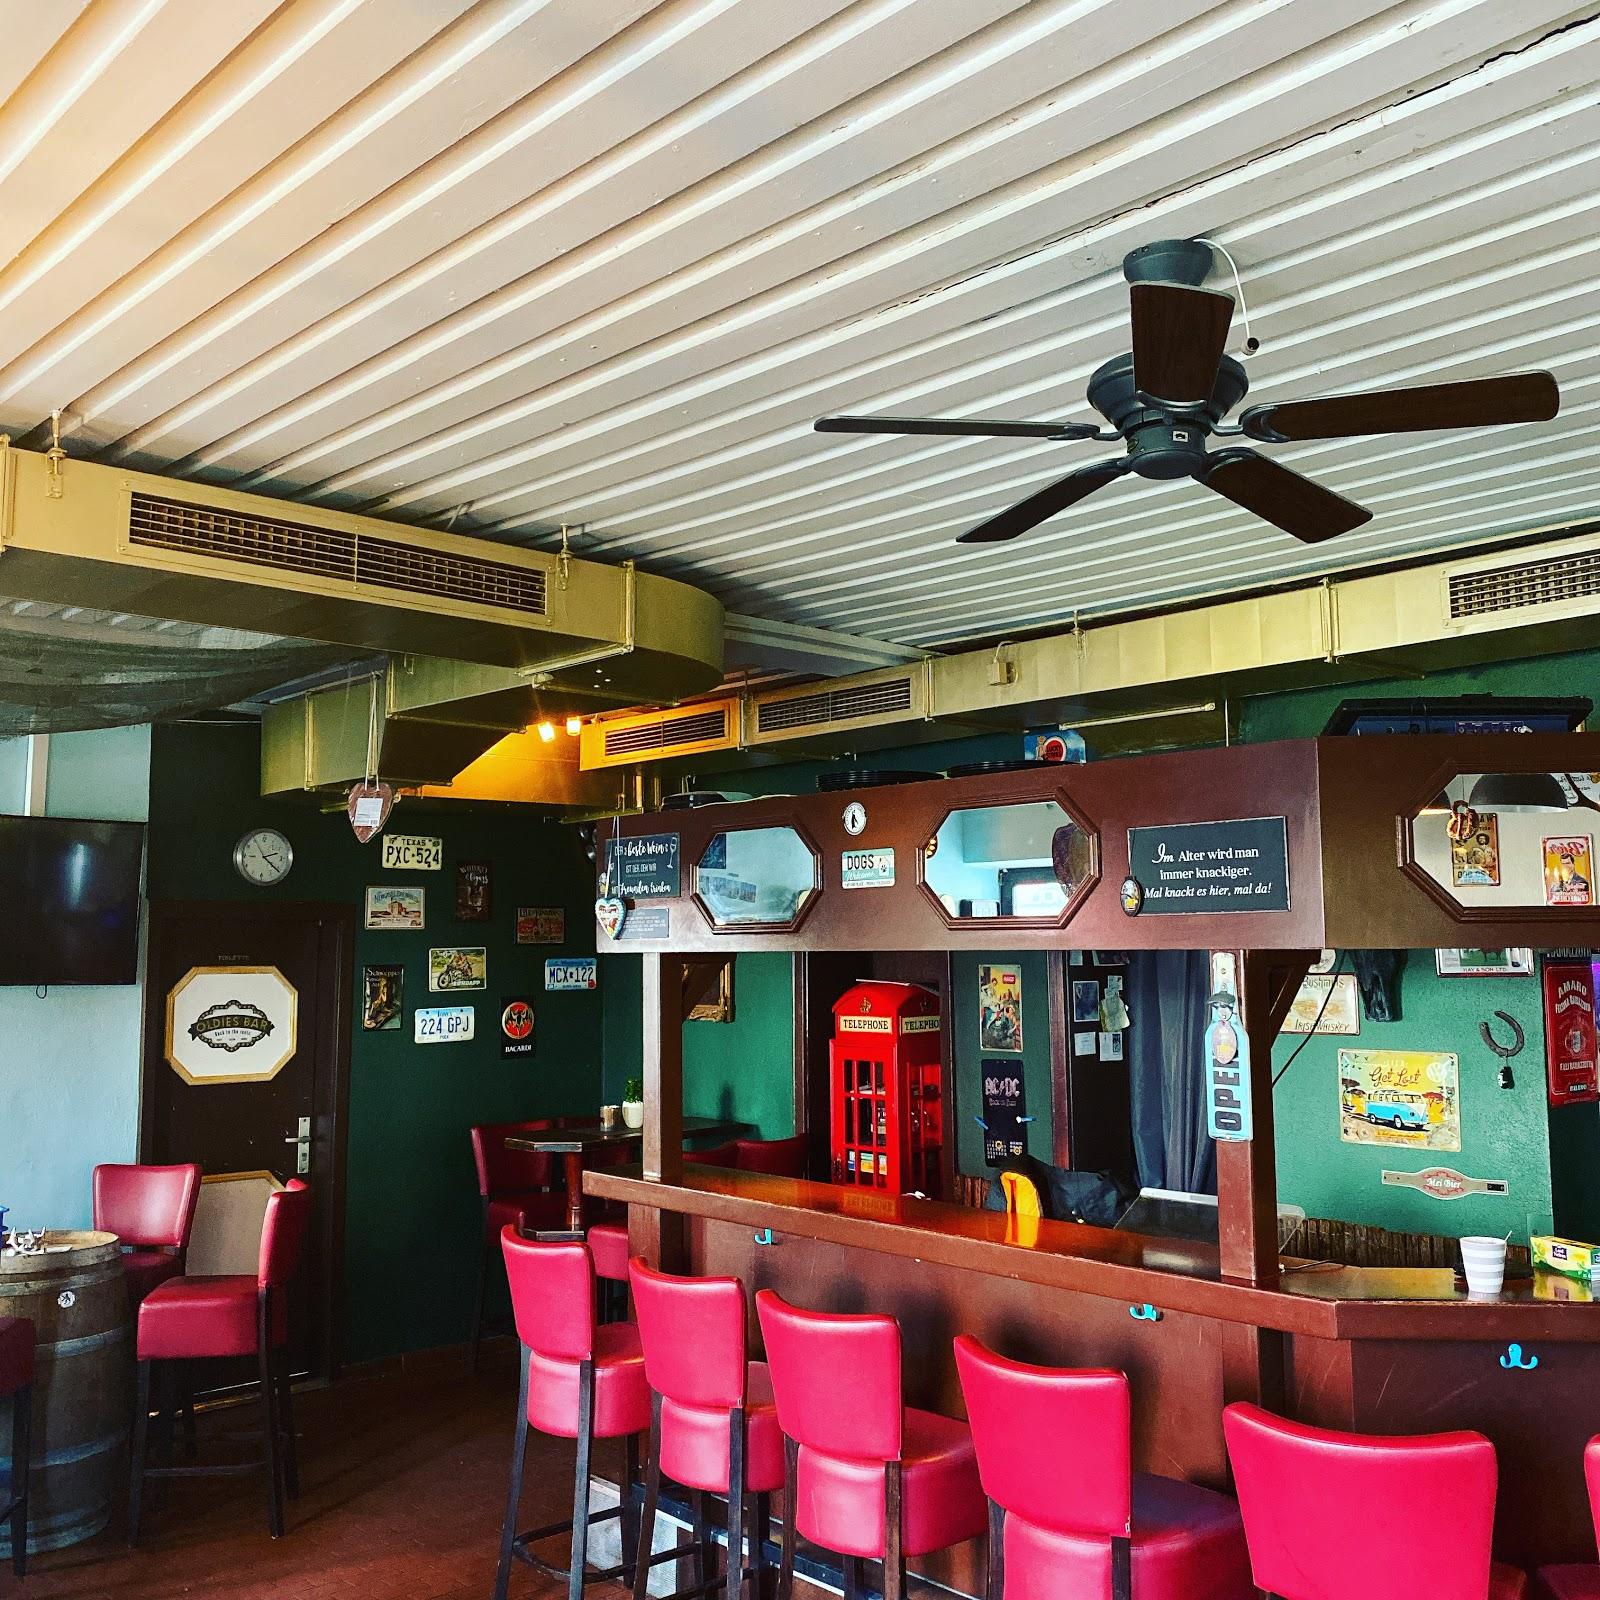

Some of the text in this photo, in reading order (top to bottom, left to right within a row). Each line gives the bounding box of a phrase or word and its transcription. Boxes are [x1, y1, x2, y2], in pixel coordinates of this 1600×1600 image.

[402, 838, 426, 846] TEXAS
[1152, 843, 1259, 863] Im Alter wird man
[847, 854, 874, 870] DOGS
[1160, 866, 1252, 880] immer knackiger.
[1144, 882, 1272, 898] Mal knackt es hier, mal da!
[1558, 980, 1587, 998] AMARO
[196, 1016, 269, 1032] OLDIES BAR
[421, 1016, 470, 1035] 224 GPJ
[843, 1019, 889, 1030] TELEPHONE
[505, 1044, 532, 1053] BACARDI
[1369, 1066, 1422, 1087] Get Lost
[985, 1077, 1020, 1097] AC/DC
